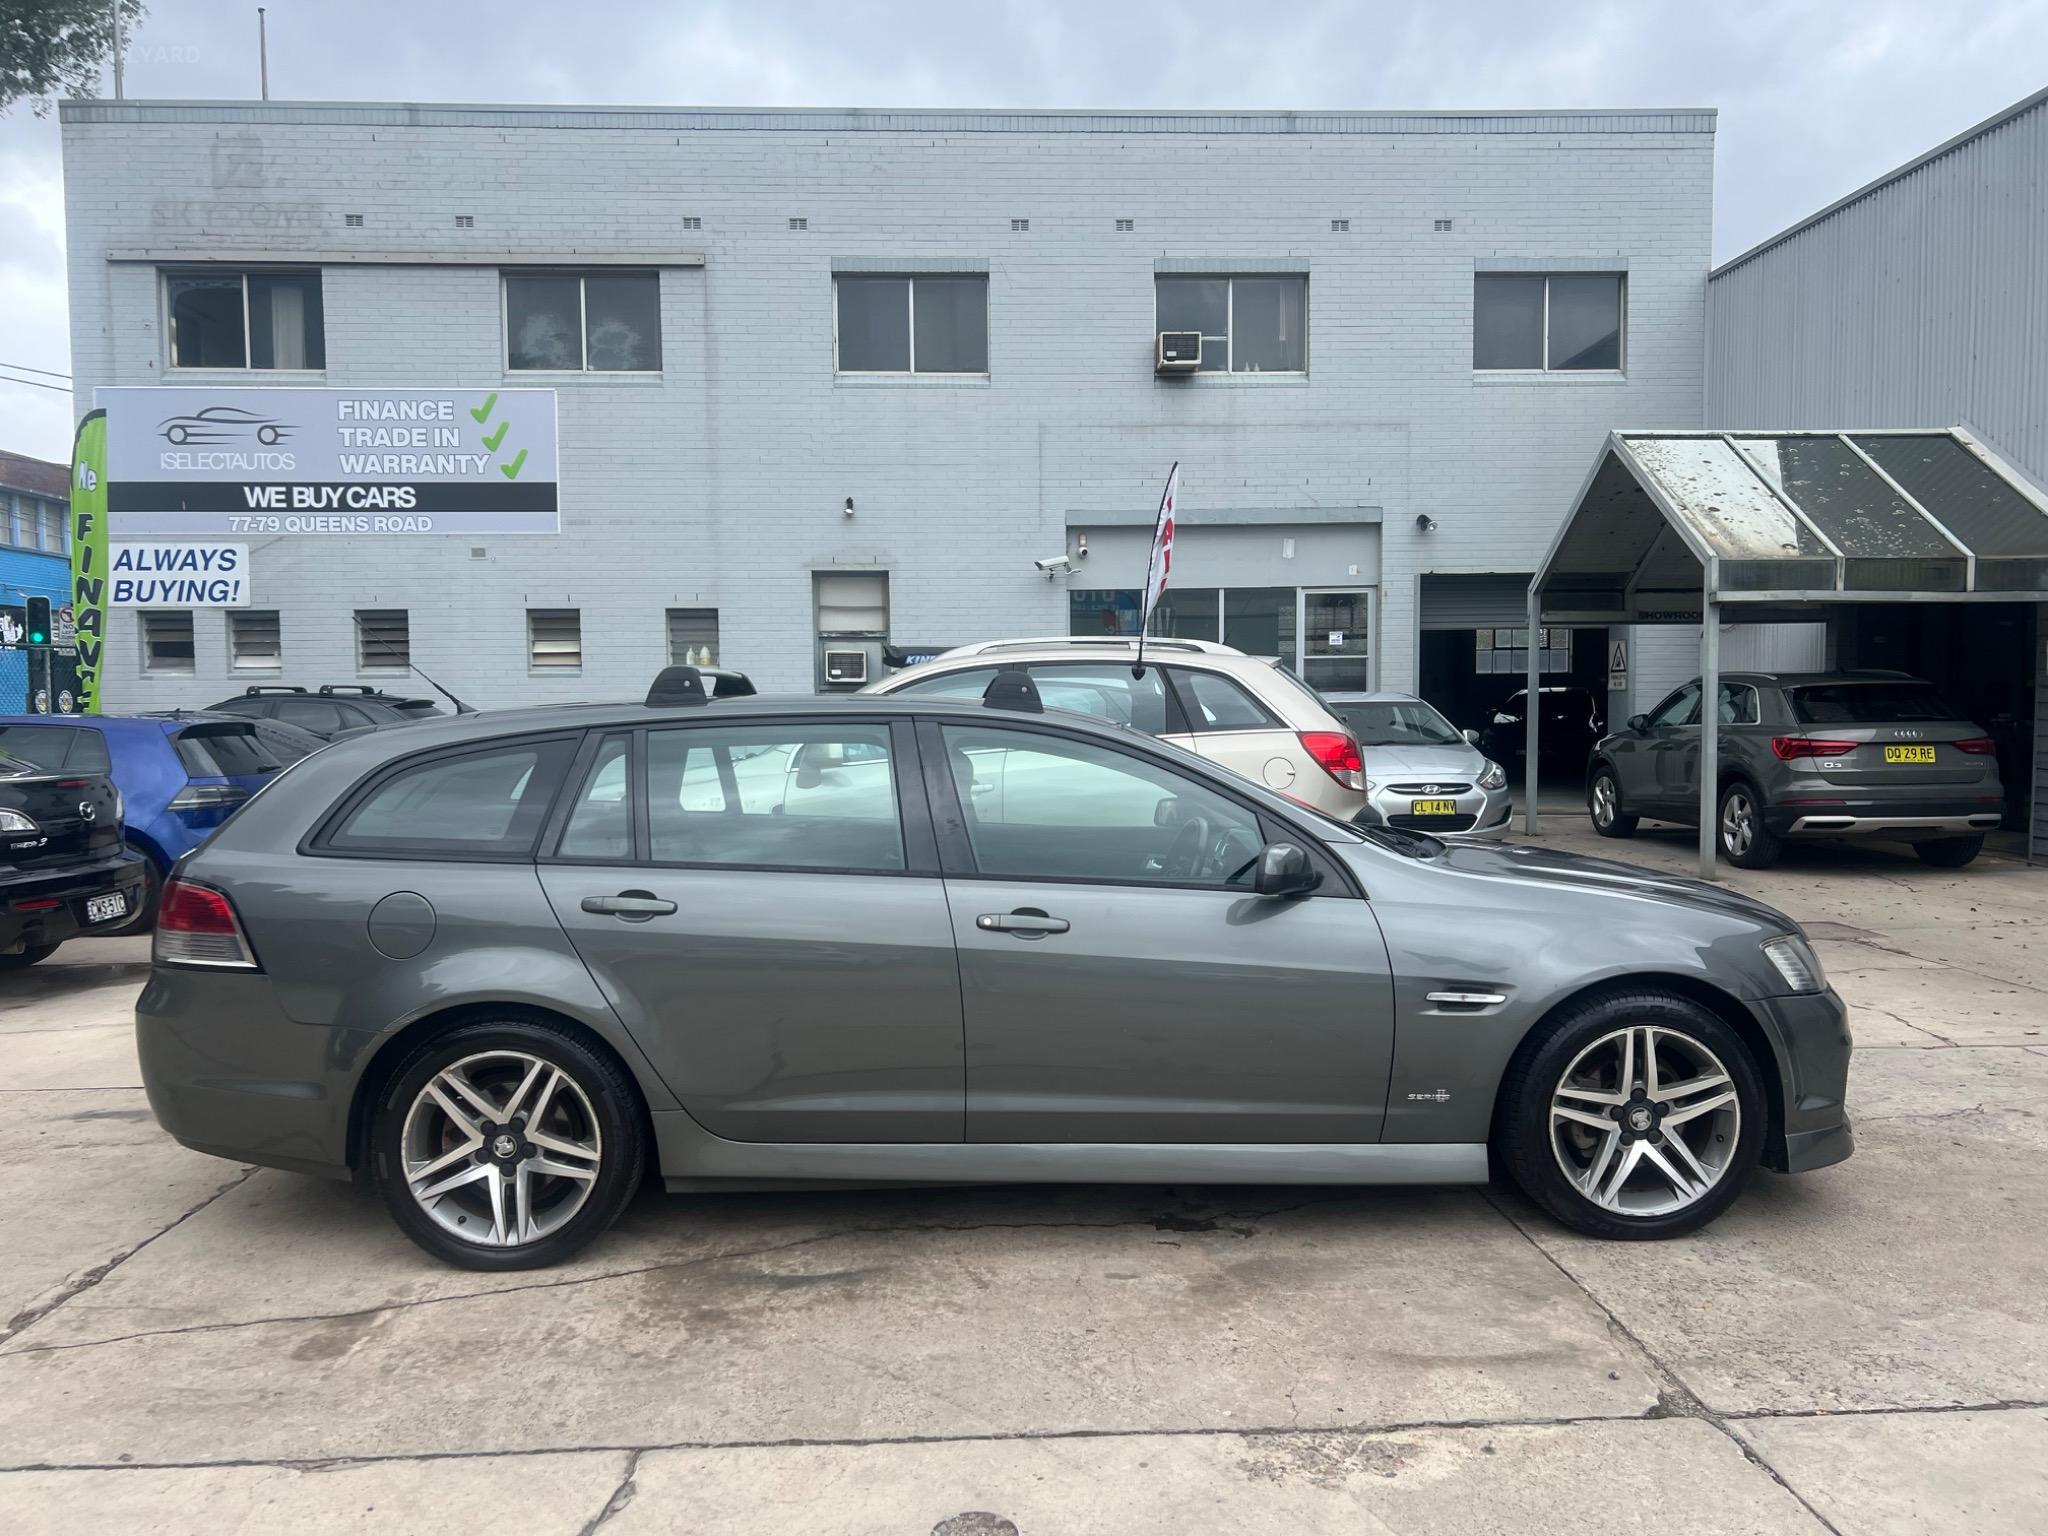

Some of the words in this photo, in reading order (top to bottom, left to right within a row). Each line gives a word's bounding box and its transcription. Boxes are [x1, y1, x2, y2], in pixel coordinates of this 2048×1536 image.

[337, 400, 454, 420] FINANCE
[337, 427, 428, 447] TRADE
[433, 427, 460, 447] IN
[160, 452, 296, 471] ISELECTAUTOS
[338, 453, 491, 474] WARRANTY
[243, 486, 287, 508] WE
[292, 486, 345, 508] BUY
[346, 486, 417, 508] CARS
[228, 516, 280, 532] 77-79
[285, 516, 369, 533] QUEENS
[374, 516, 433, 532] ROAD
[113, 549, 238, 572] ALWAYS
[113, 580, 241, 602] BUYING!
[1639, 611, 1703, 620] SHOWROO
[1887, 748, 1901, 759] DQ
[1905, 748, 1917, 759] 29
[1920, 748, 1933, 759] RE
